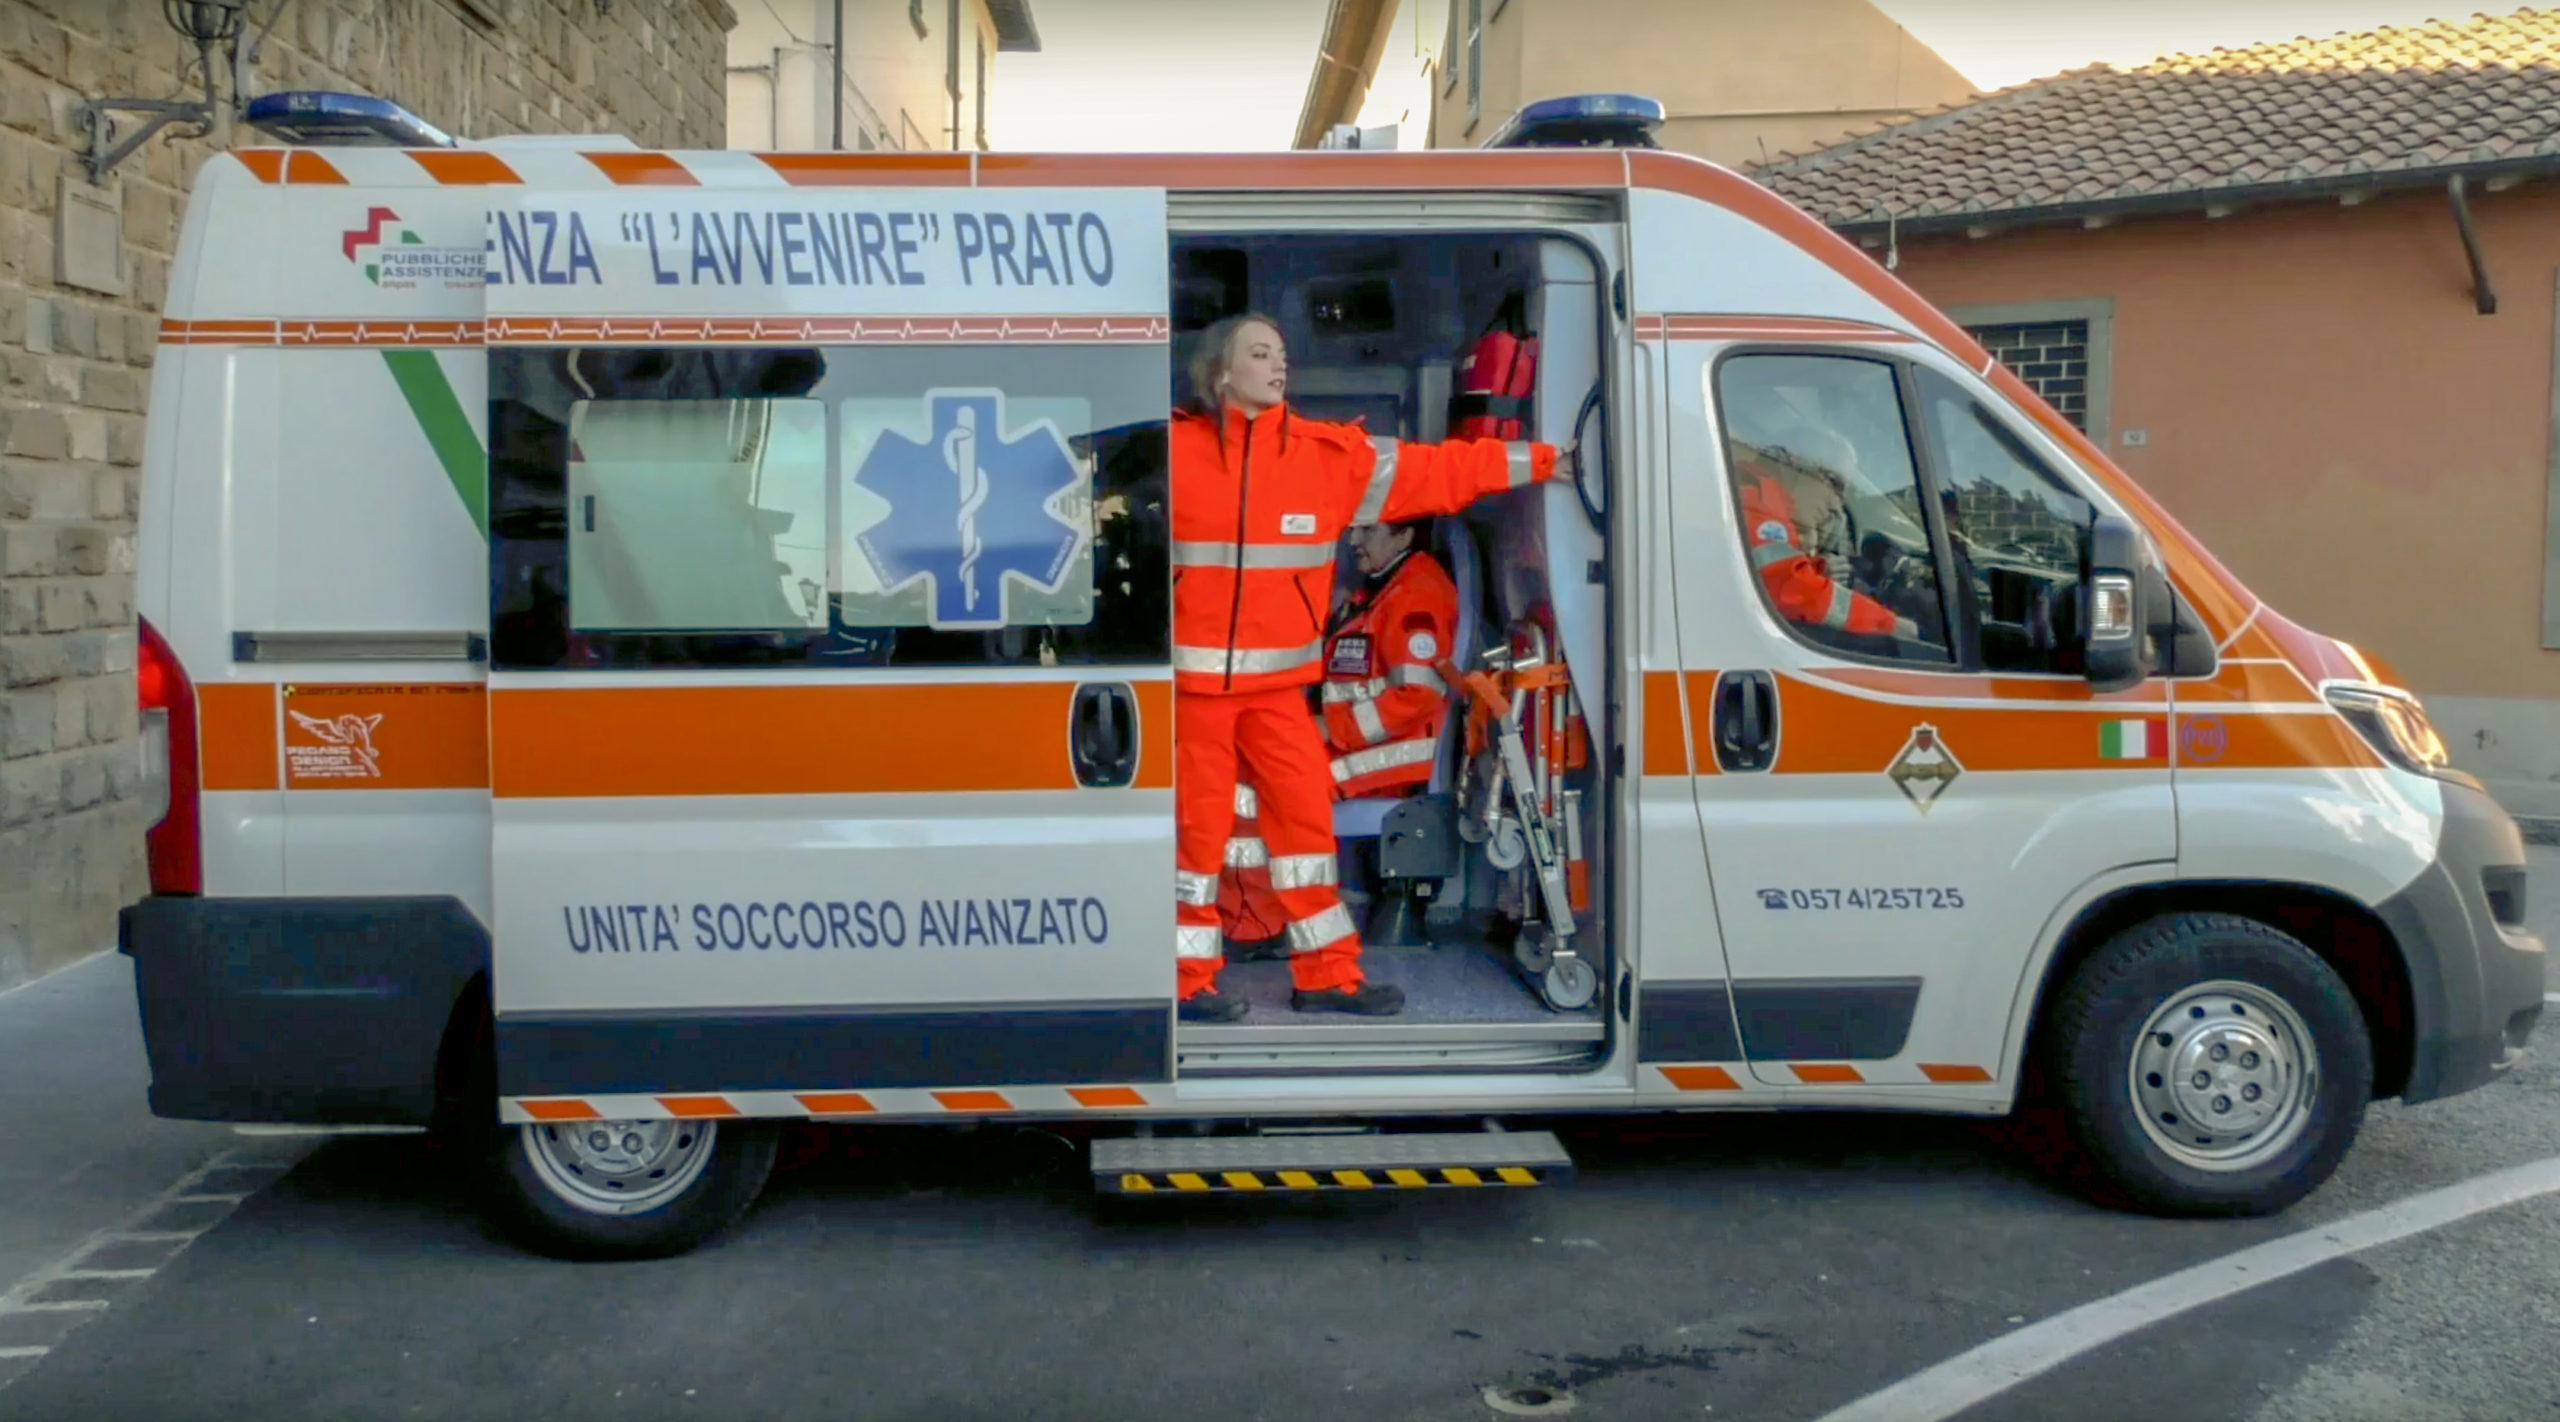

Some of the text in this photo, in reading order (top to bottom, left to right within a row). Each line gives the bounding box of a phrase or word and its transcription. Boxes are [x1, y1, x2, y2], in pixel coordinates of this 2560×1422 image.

[382, 253, 486, 265] PUBBLICHE
[952, 211, 1114, 287] PRATO
[382, 266, 486, 278] ASSISTENZE
[564, 896, 1109, 954] UNITA' SOCCORSO AVANZATO
